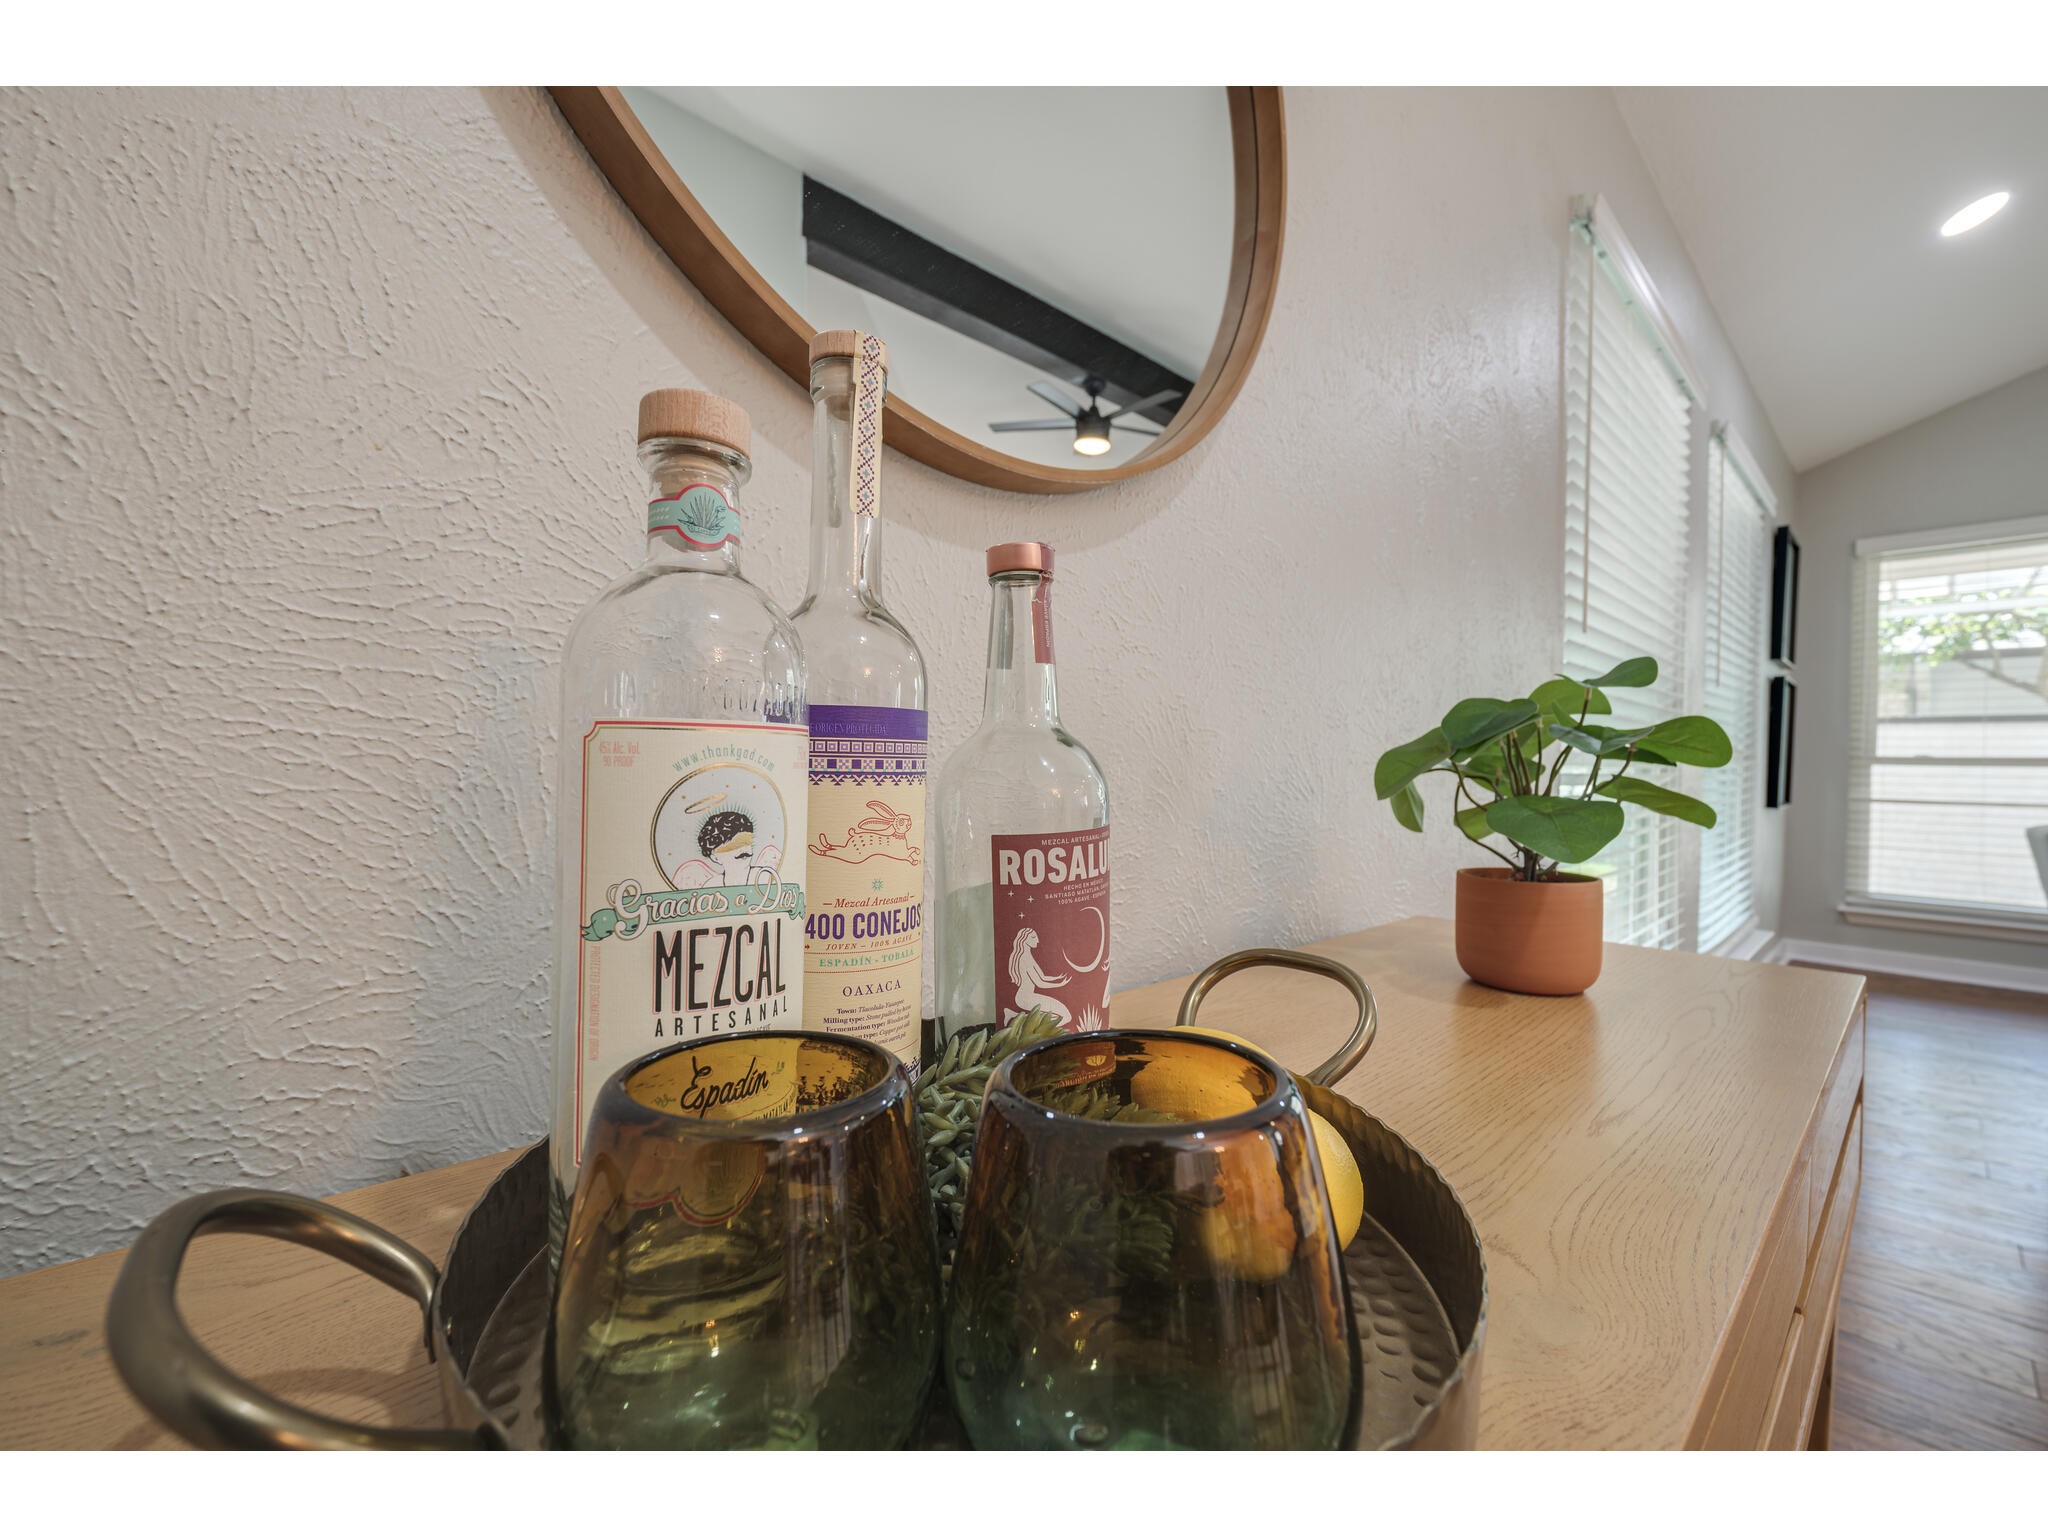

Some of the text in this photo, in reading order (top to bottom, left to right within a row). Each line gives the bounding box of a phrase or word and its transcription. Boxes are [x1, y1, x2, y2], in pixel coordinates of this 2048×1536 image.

[672, 743, 775, 772] www.thankgod.com
[1041, 838, 1070, 846] MEZCAL
[605, 867, 798, 941] Gracias a Dios
[834, 892, 909, 908] Mezcal Artesanal
[804, 903, 922, 940] 400 CONEJOS
[870, 940, 889, 948] 100%
[653, 918, 787, 1014] MEZCAL
[819, 954, 872, 967] ESPADÍN
[842, 979, 901, 997] OAXACA
[655, 996, 787, 1038] ARTESANAL
[849, 1016, 865, 1024] type:
[826, 1023, 871, 1032] Fermentation
[871, 1021, 886, 1030] type:
[680, 1055, 769, 1119] Espadín
